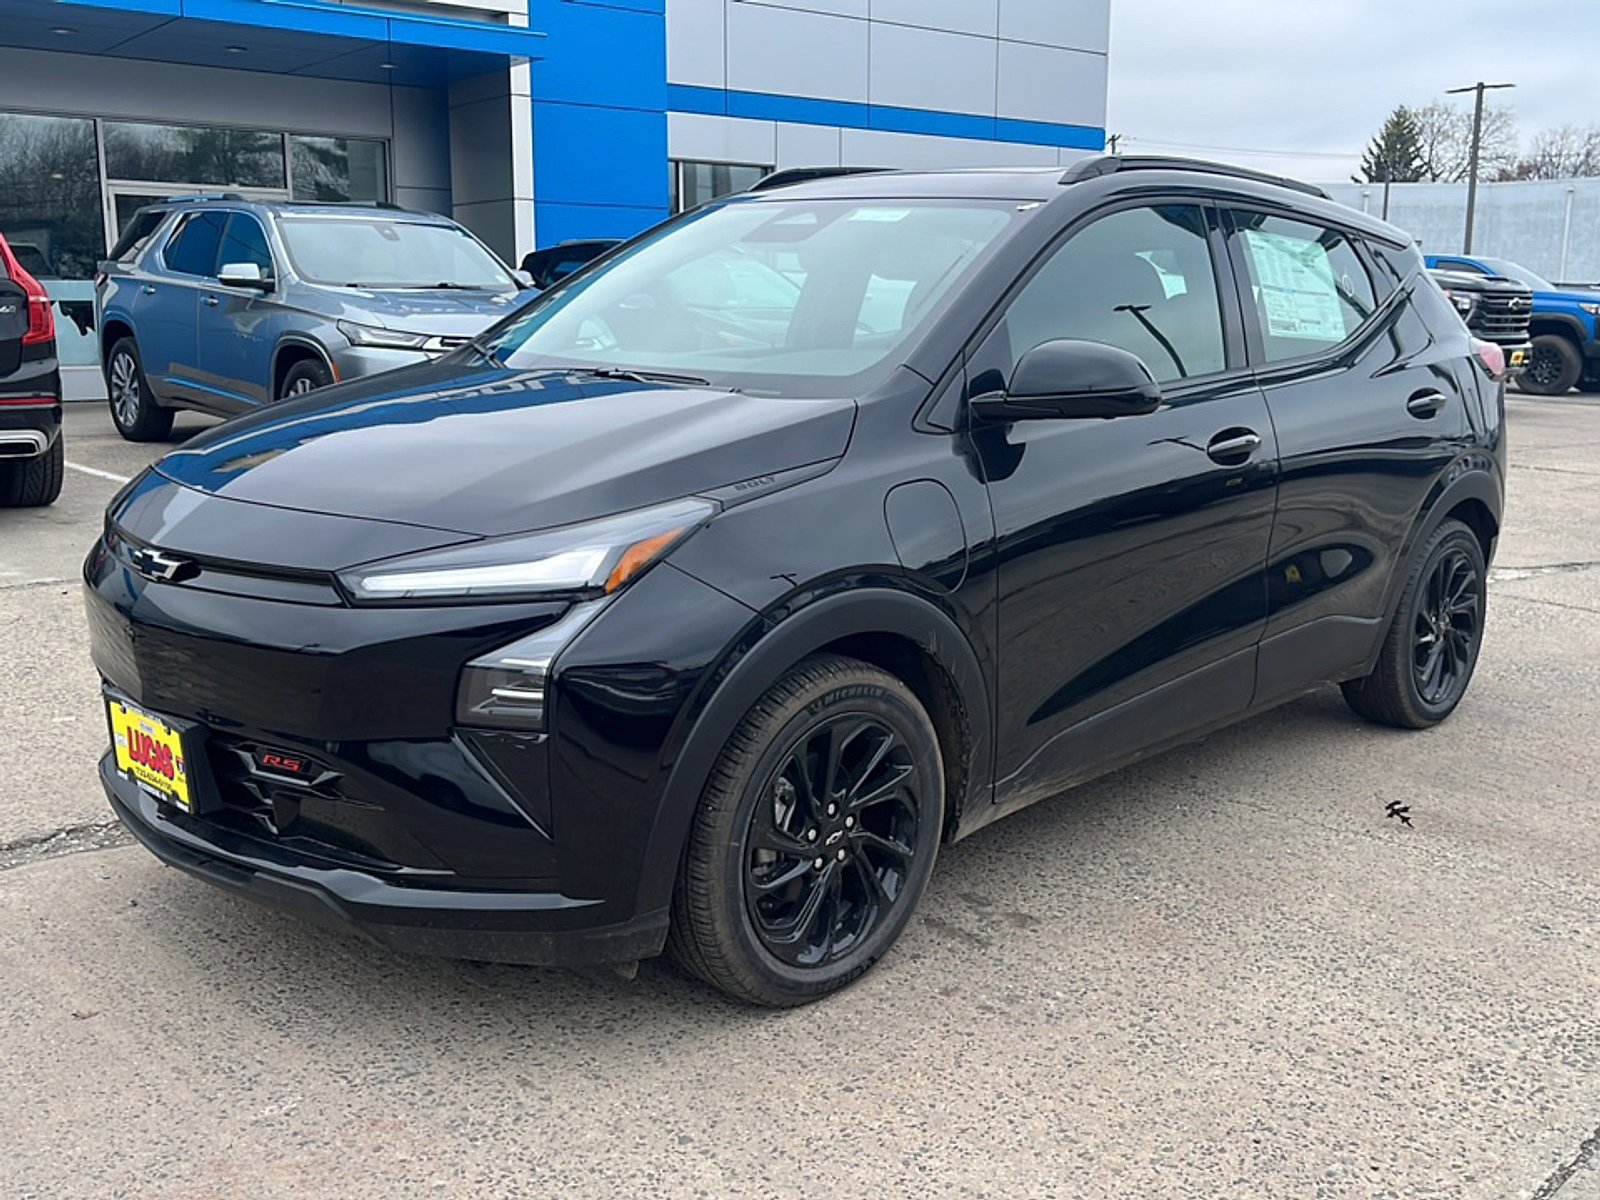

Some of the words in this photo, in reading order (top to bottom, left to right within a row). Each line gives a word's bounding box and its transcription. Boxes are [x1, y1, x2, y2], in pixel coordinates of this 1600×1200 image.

[736, 476, 776, 491] BOLT
[825, 687, 884, 705] MICHELIN
[126, 726, 175, 781] LUCAS
[262, 754, 303, 772] RS
